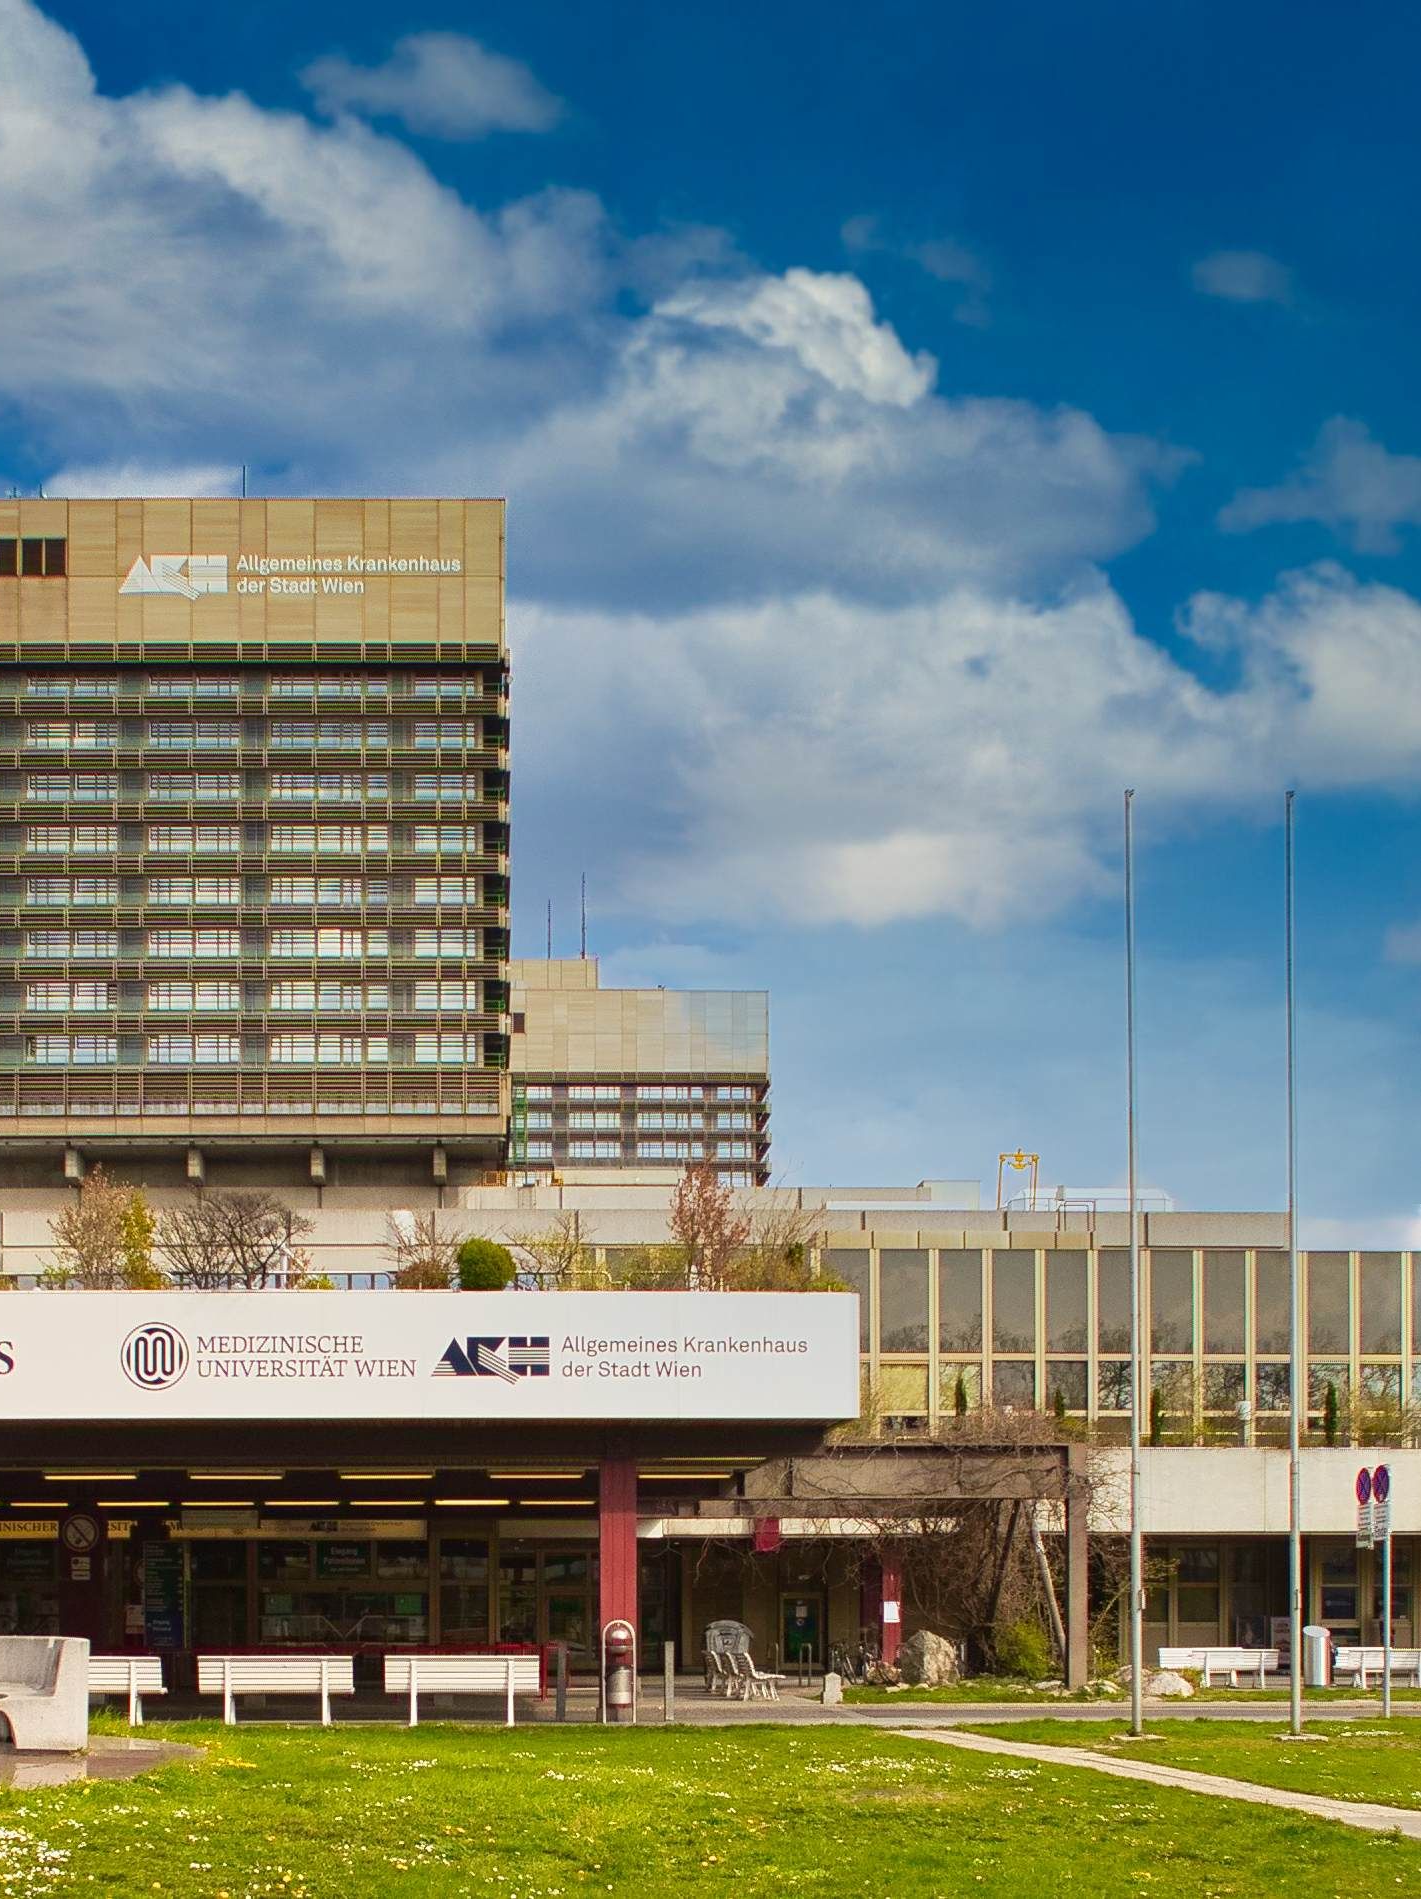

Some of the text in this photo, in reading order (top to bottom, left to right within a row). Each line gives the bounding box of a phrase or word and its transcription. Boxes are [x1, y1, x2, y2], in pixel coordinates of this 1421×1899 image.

[236, 554, 462, 576] Allgemeines Krankenhaus
[236, 576, 365, 595] der Stadt Wien
[197, 1336, 364, 1354] MEDIZINISCHE
[561, 1336, 808, 1358] Allgemeines Krankenhaus
[197, 1356, 417, 1377] UNIVERSITÄT WIEN
[562, 1361, 702, 1378] der Stadt Wien
